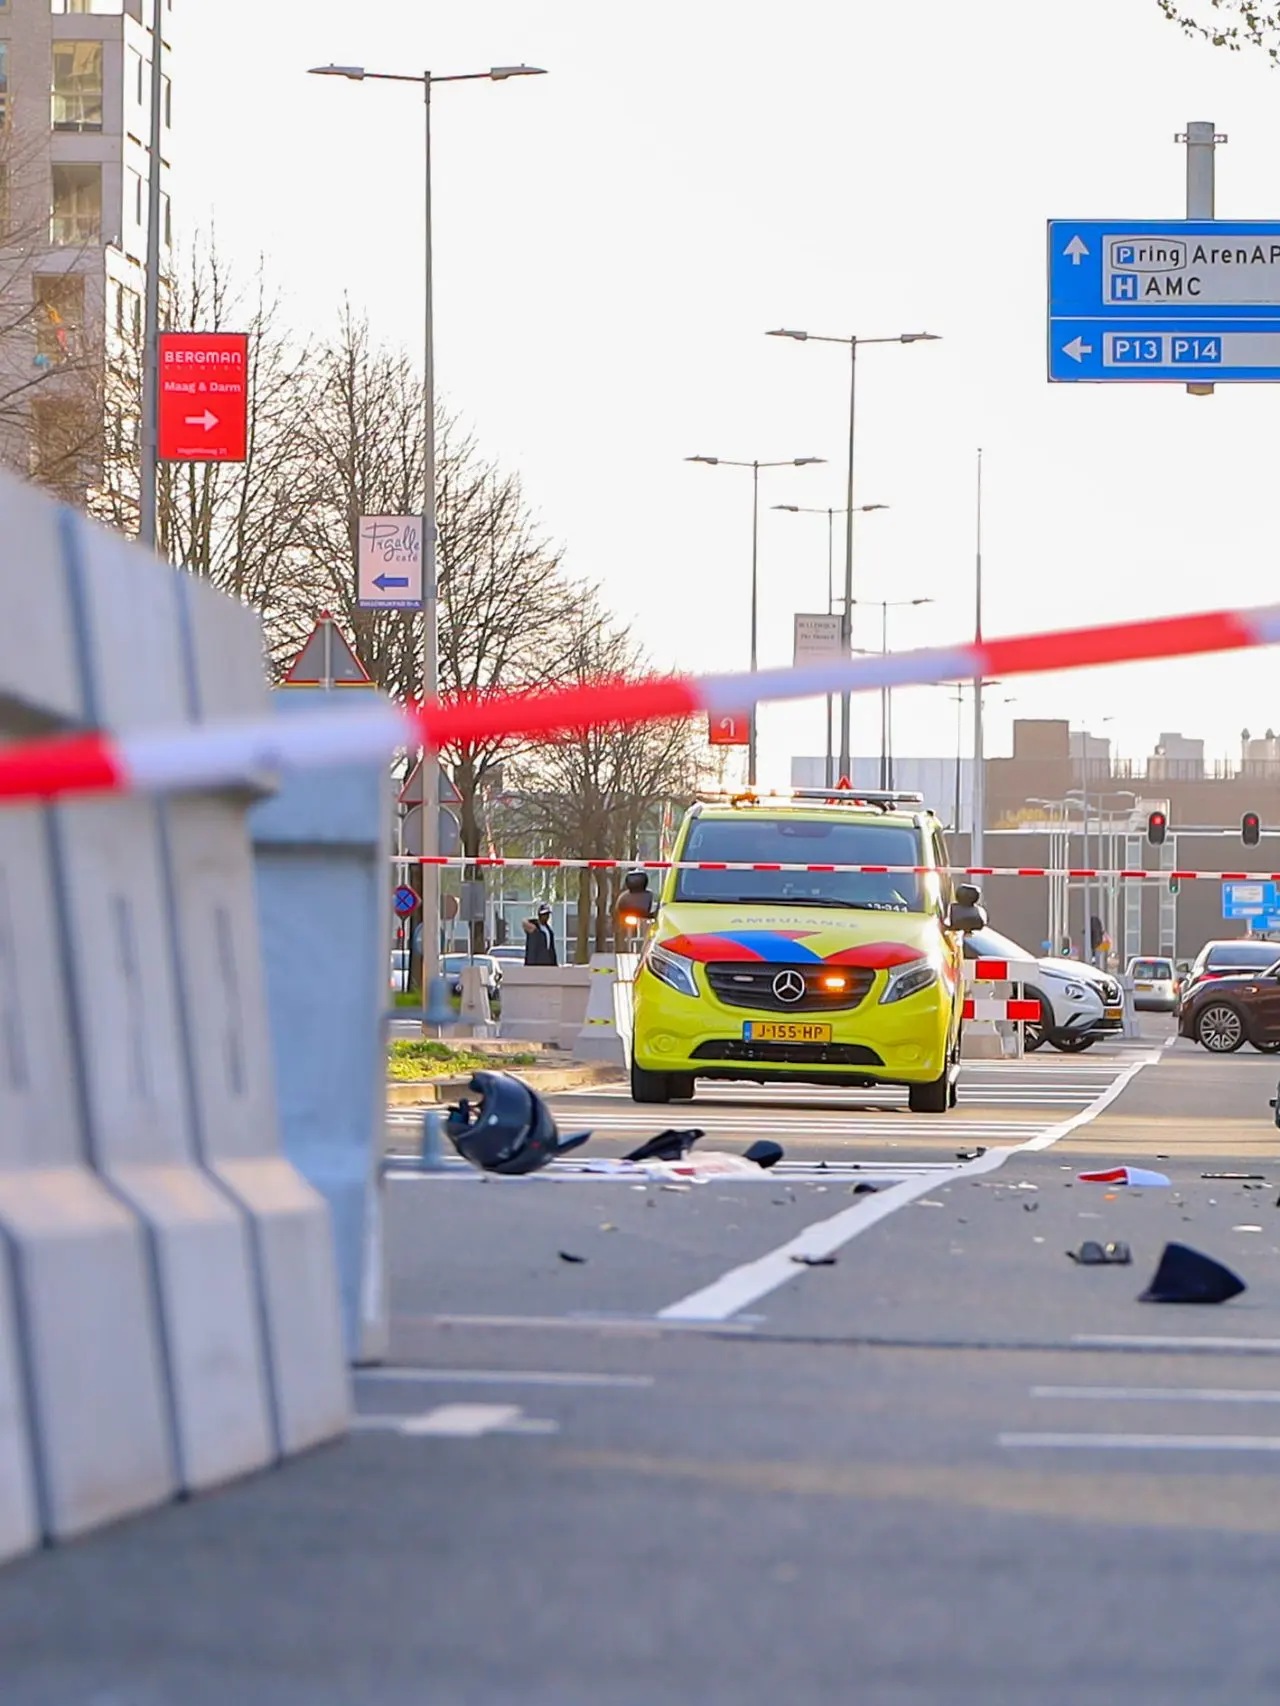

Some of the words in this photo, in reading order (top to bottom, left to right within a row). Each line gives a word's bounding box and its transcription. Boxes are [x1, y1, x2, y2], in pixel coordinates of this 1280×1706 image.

[1144, 277, 1201, 296] AMC
[164, 351, 241, 364] BERGMAN
[1116, 341, 1158, 359] P13
[1175, 341, 1218, 360] P14
[164, 382, 196, 394] Maag
[209, 382, 241, 392] Darm
[730, 917, 859, 928] AMBULANCE
[757, 1024, 823, 1039] J-155-HP
